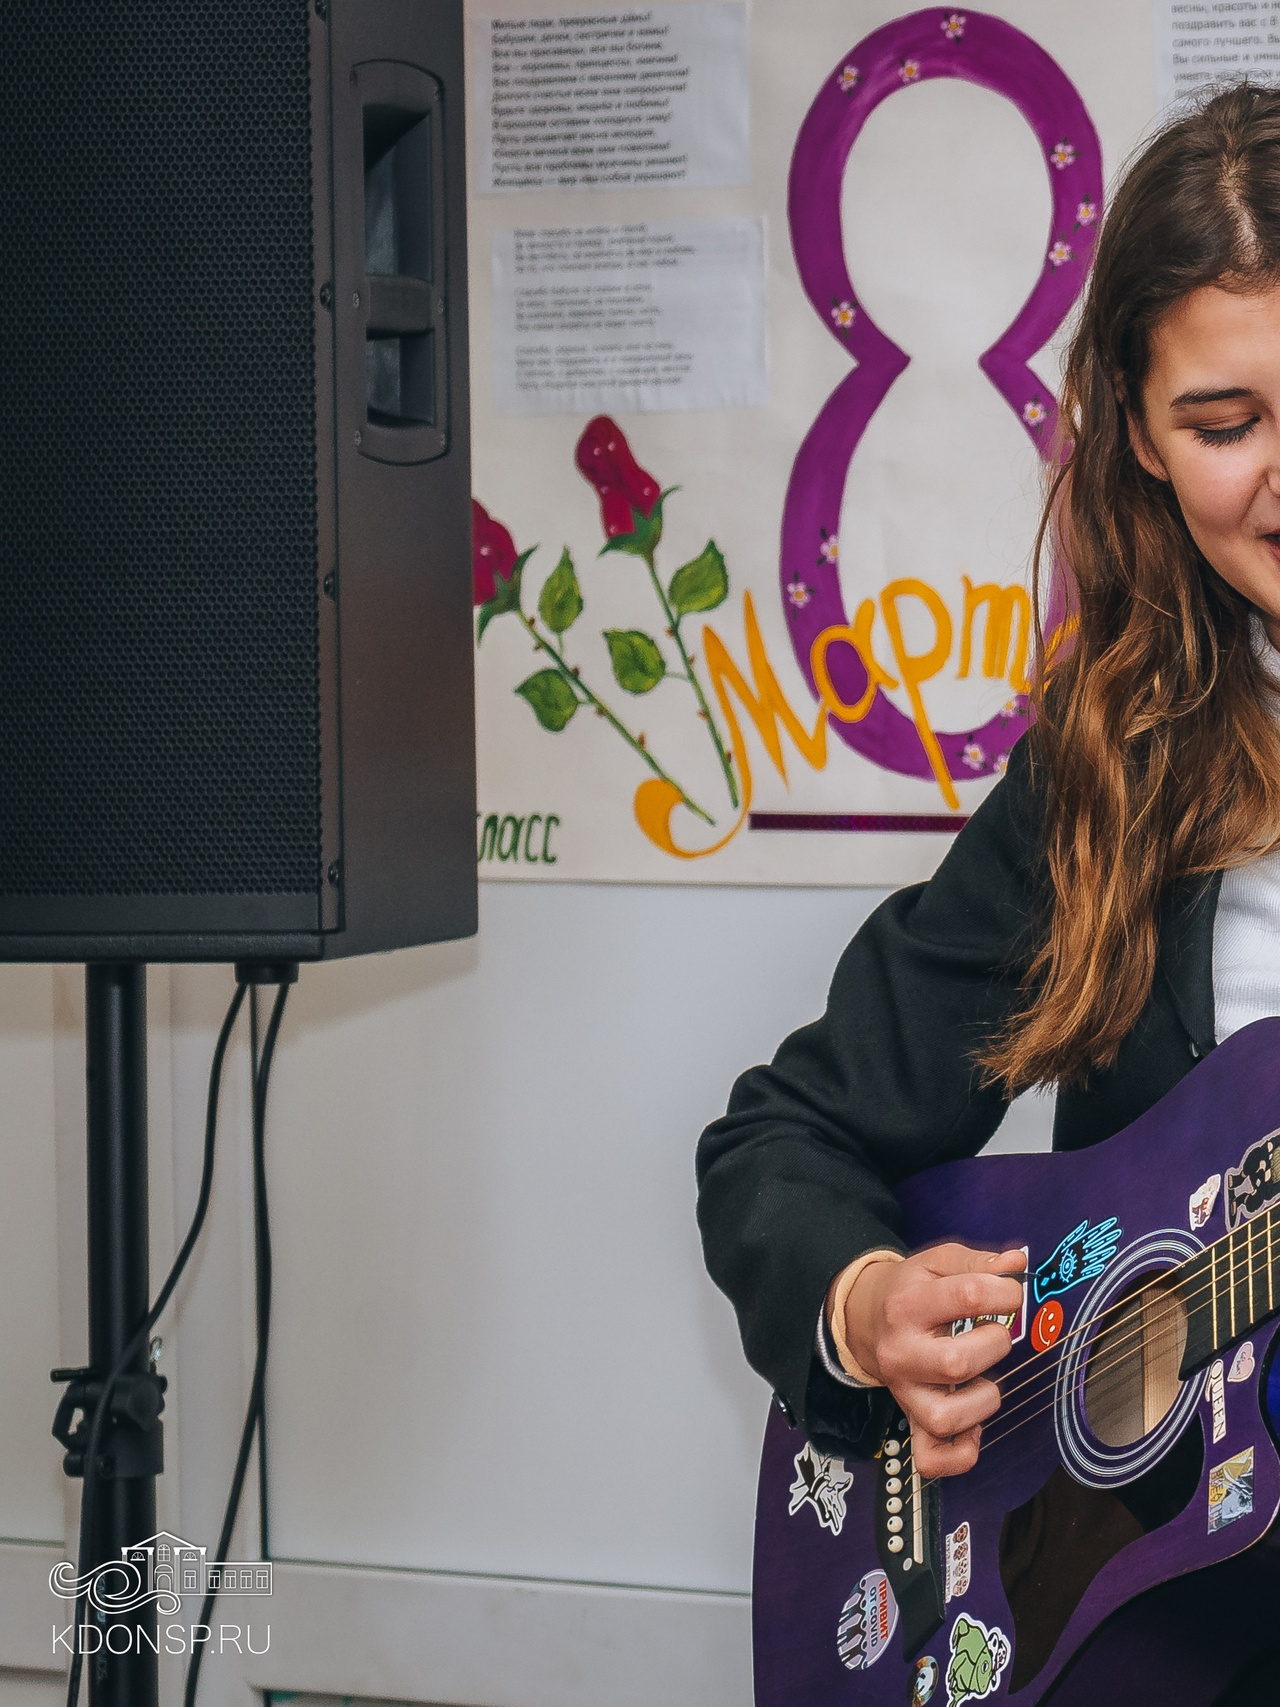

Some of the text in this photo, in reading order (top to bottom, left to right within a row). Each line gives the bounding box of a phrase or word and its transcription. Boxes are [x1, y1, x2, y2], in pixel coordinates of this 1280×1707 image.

[1172, 18, 1235, 32] поздравить
[1172, 53, 1189, 65] Вы
[781, 6, 1104, 781] 8
[477, 811, 561, 864] ласс
[1206, 1360, 1225, 1440] QUEEN
[869, 1586, 878, 1648] ОТ COVID
[878, 1579, 889, 1640] ПРИВИТ
